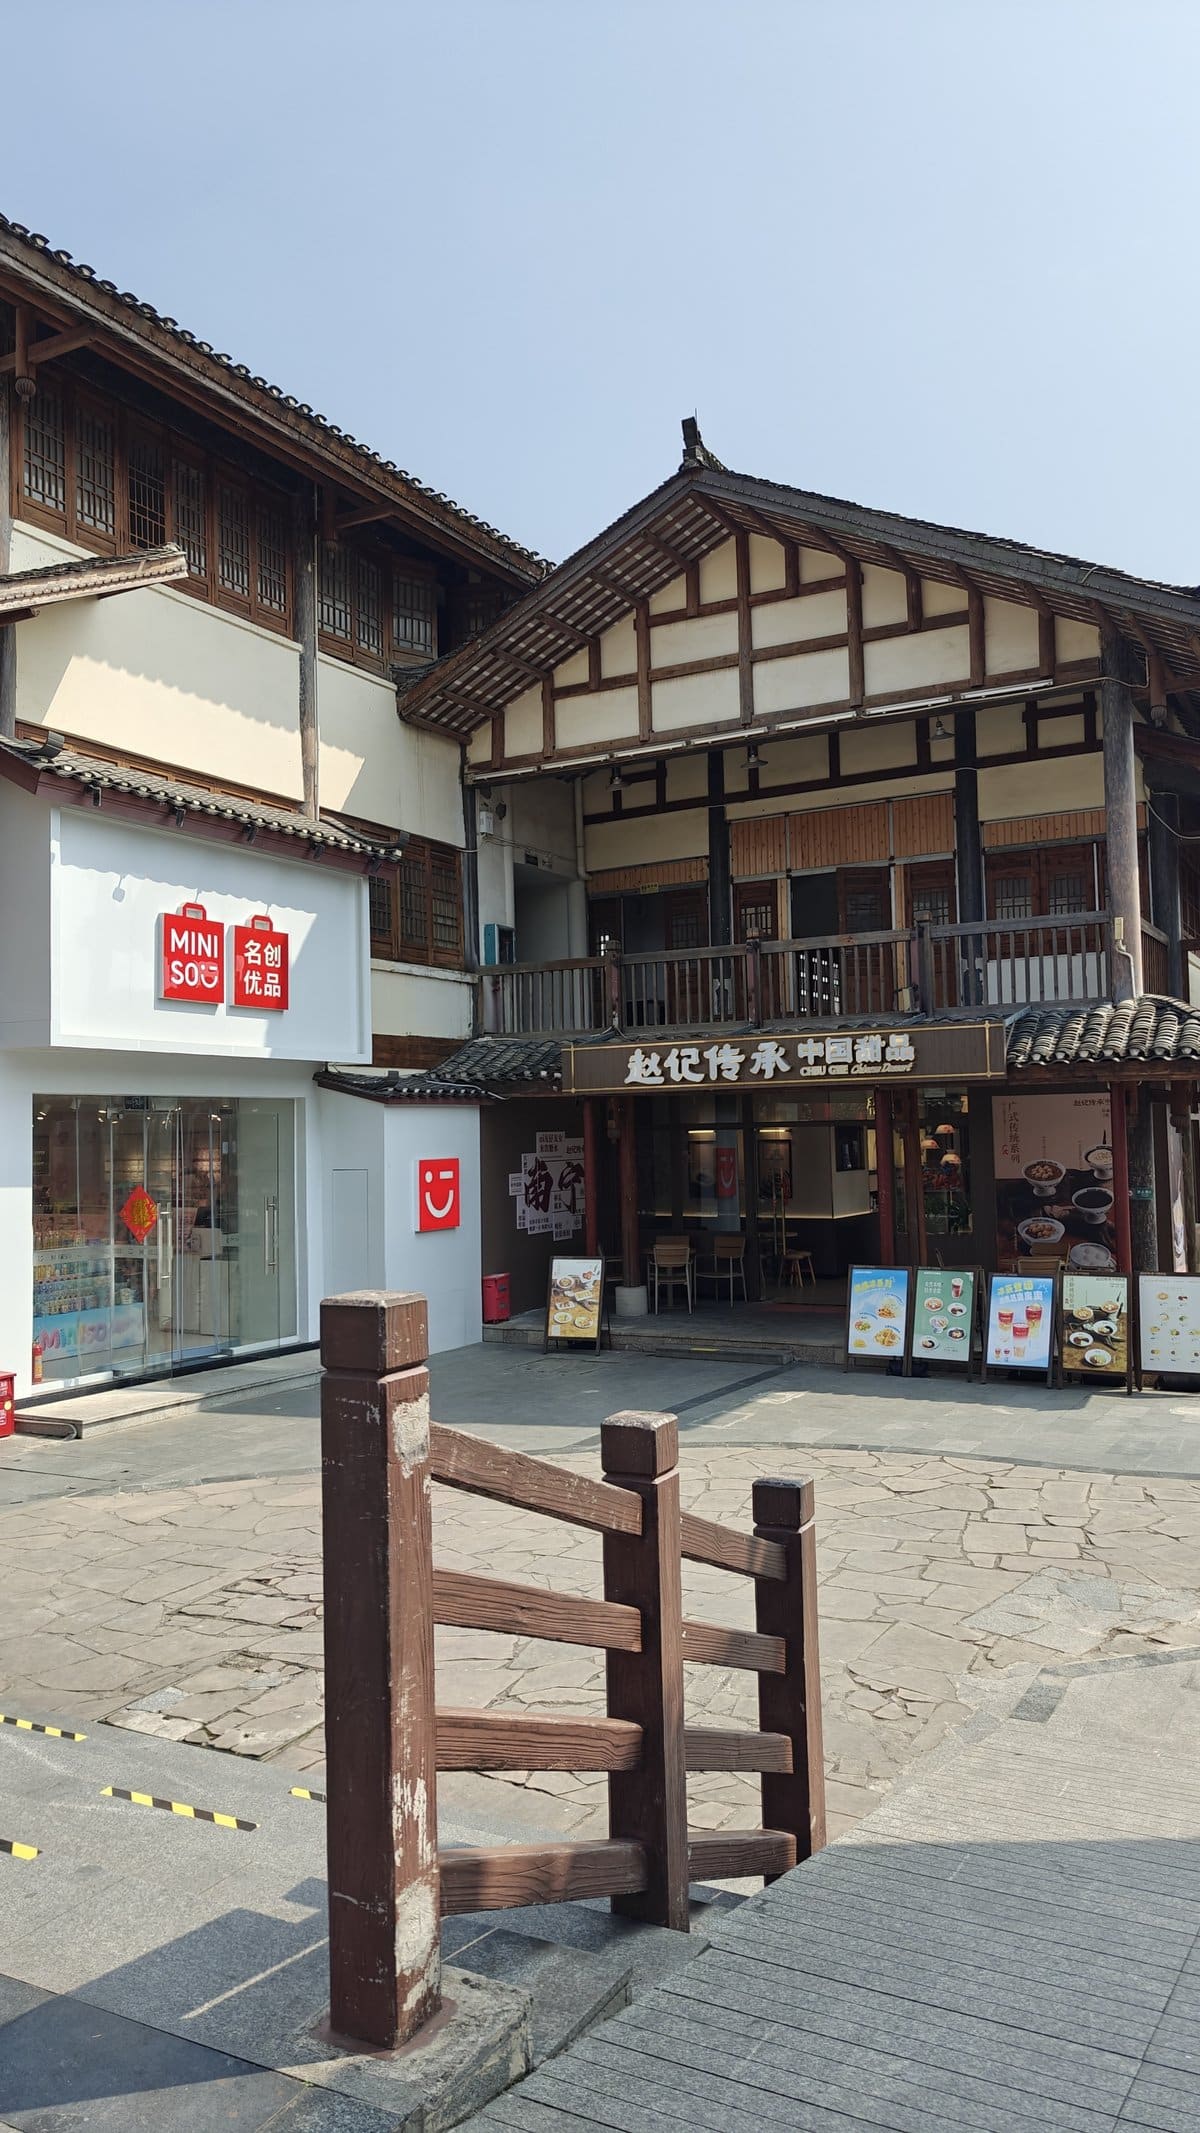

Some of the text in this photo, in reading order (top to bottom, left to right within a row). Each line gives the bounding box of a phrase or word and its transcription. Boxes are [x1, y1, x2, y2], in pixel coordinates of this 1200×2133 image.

[171, 928, 219, 958] MINI
[244, 939, 281, 968] 名创
[243, 970, 281, 997] 优品
[624, 1034, 915, 1084] 赵记传承 中国甜品
